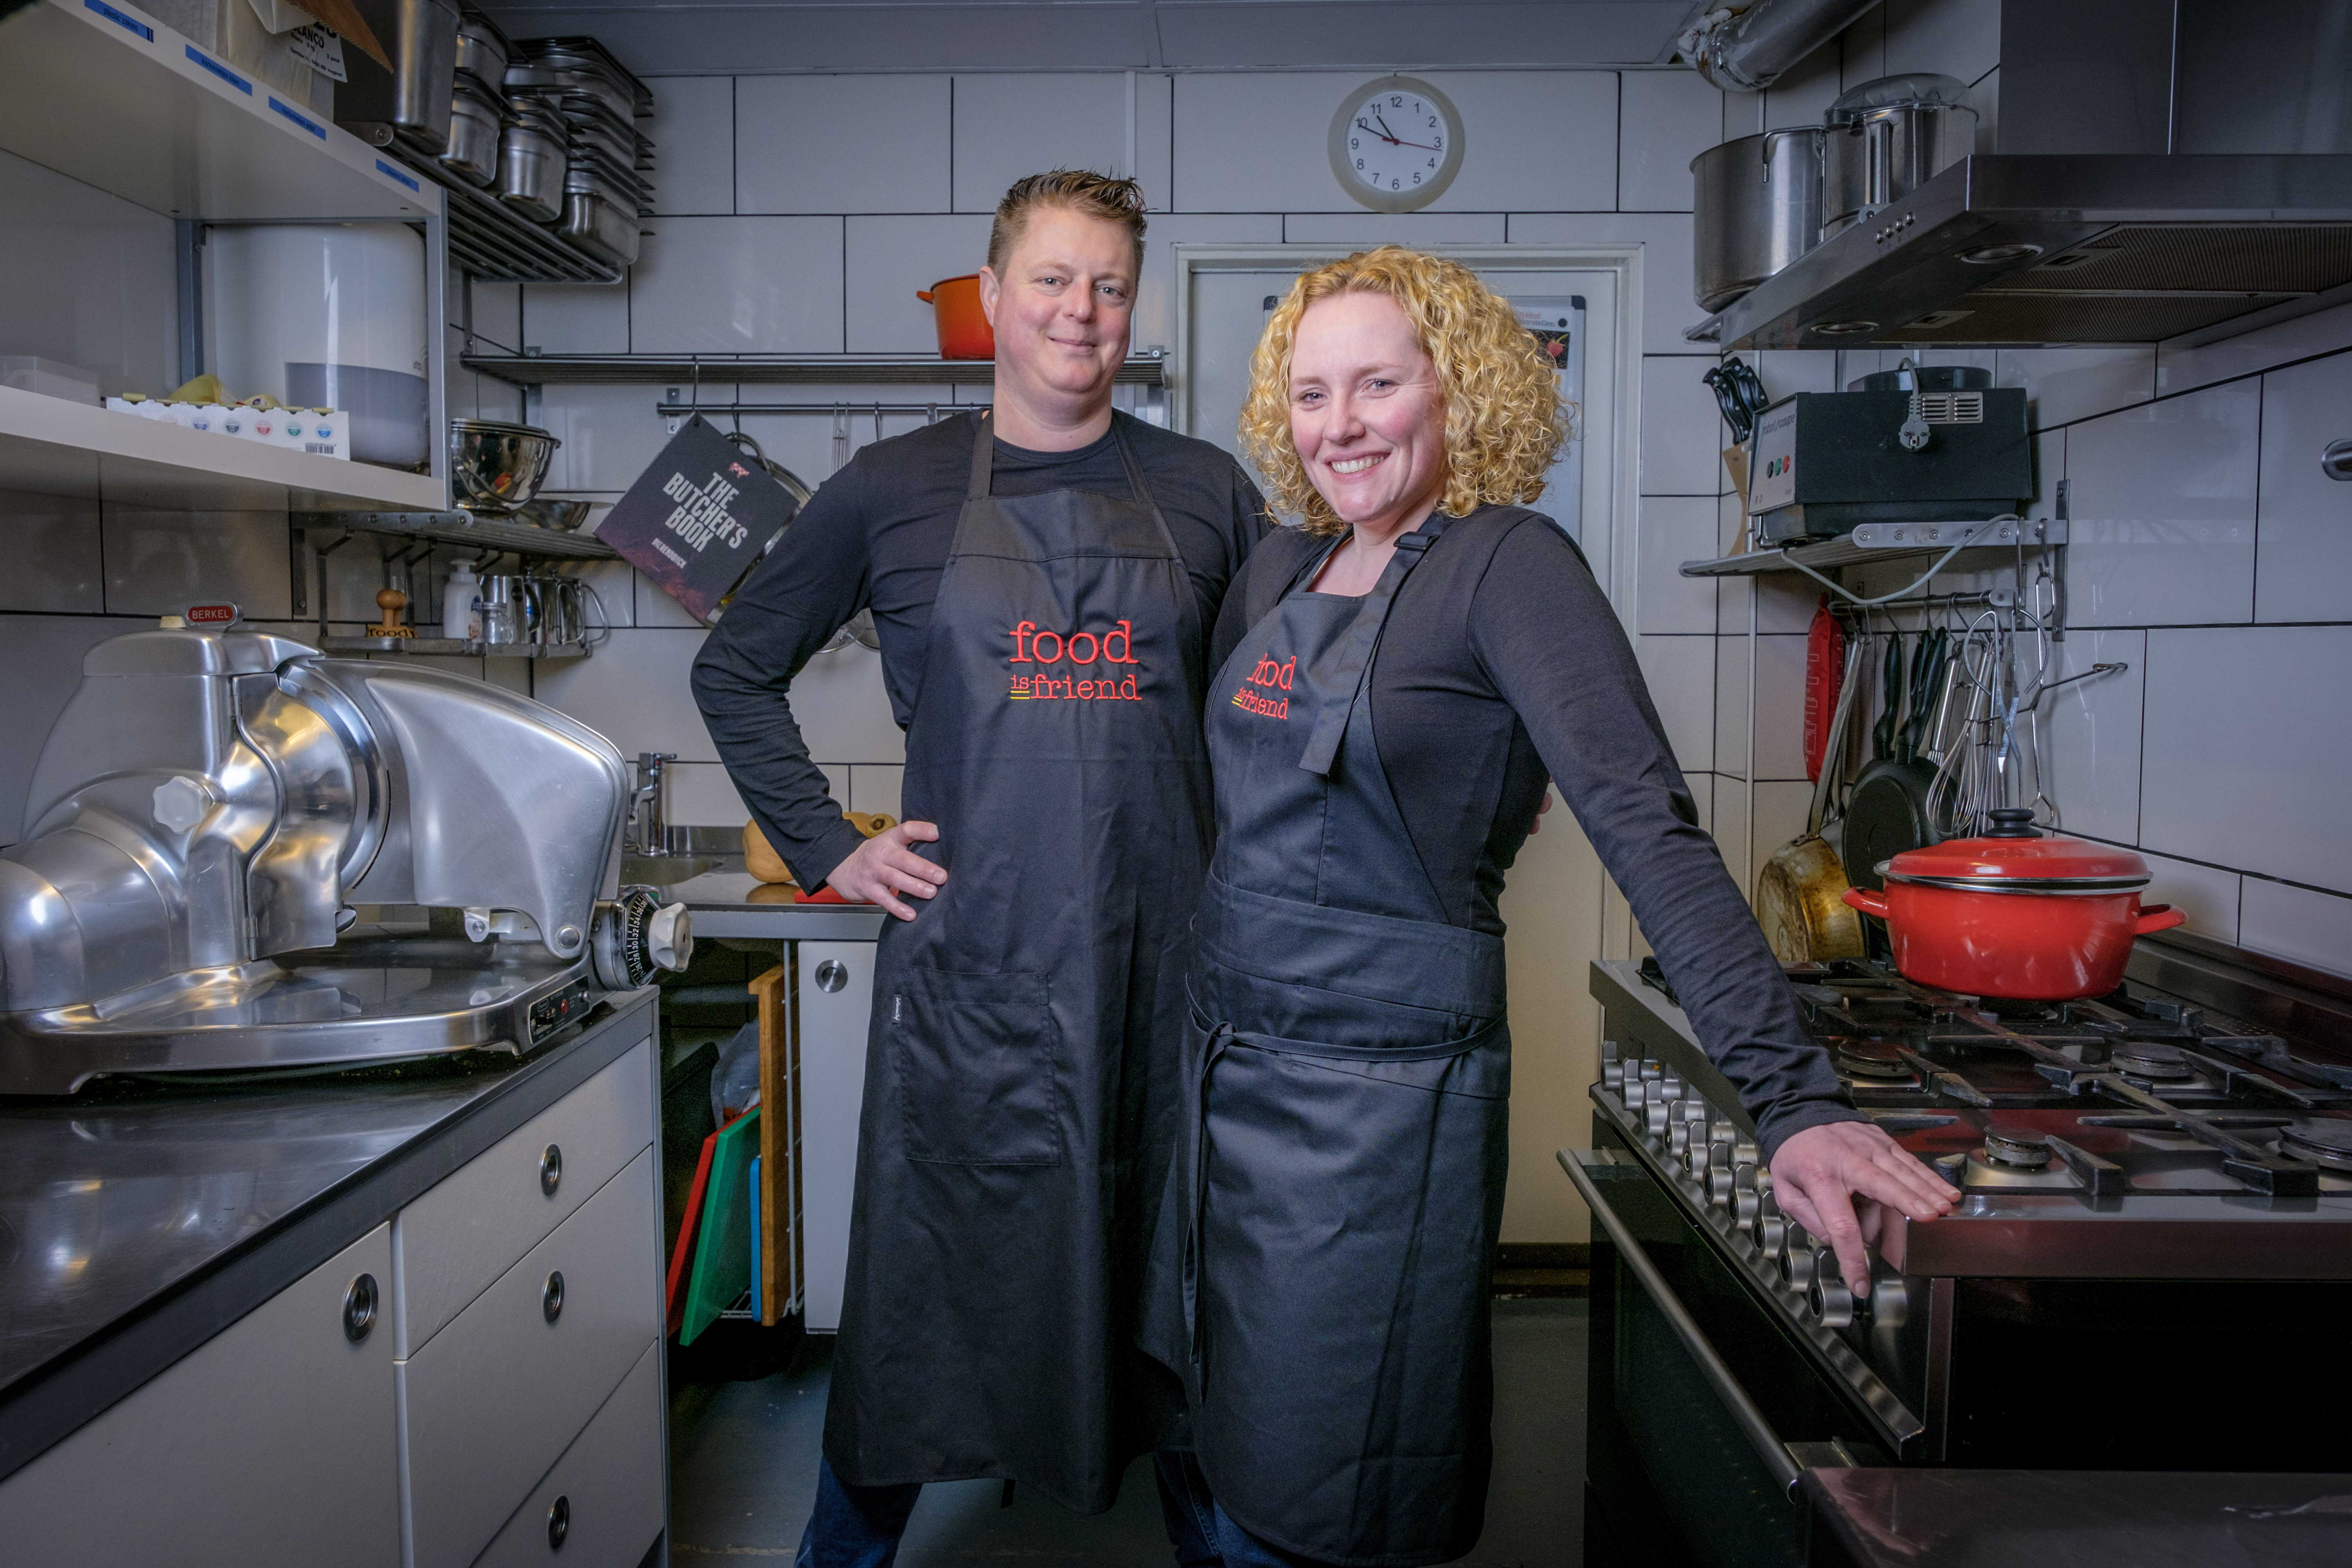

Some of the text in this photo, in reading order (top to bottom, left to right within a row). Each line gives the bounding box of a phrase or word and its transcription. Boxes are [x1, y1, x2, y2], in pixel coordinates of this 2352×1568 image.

[104, 8, 120, 22] plastic
[293, 26, 324, 48] LANCO
[1390, 96, 1402, 107] 12
[1371, 103, 1381, 114] 11
[1414, 103, 1419, 113] 1
[1356, 117, 1367, 128] 10
[1429, 116, 1436, 127] 2
[1351, 138, 1359, 149] 9
[1434, 136, 1441, 148] 3
[1357, 158, 1364, 170] 8
[1428, 157, 1435, 168] 4
[1372, 173, 1380, 184] 7
[1413, 172, 1421, 183] 5
[1392, 178, 1399, 190] 6
[703, 472, 739, 510] THE
[662, 471, 748, 549] BUTCHER'S
[664, 505, 714, 553] BOOK
[192, 609, 229, 619] BERKEL
[370, 628, 408, 637] food
[1009, 620, 1139, 665] food
[1030, 673, 1142, 700] friend
[1238, 690, 1288, 720] friend
[637, 906, 644, 915] 36
[634, 917, 640, 926] 34
[632, 929, 639, 937] 32
[632, 941, 639, 950] 30
[633, 953, 639, 961] 28
[635, 963, 643, 971] 26
